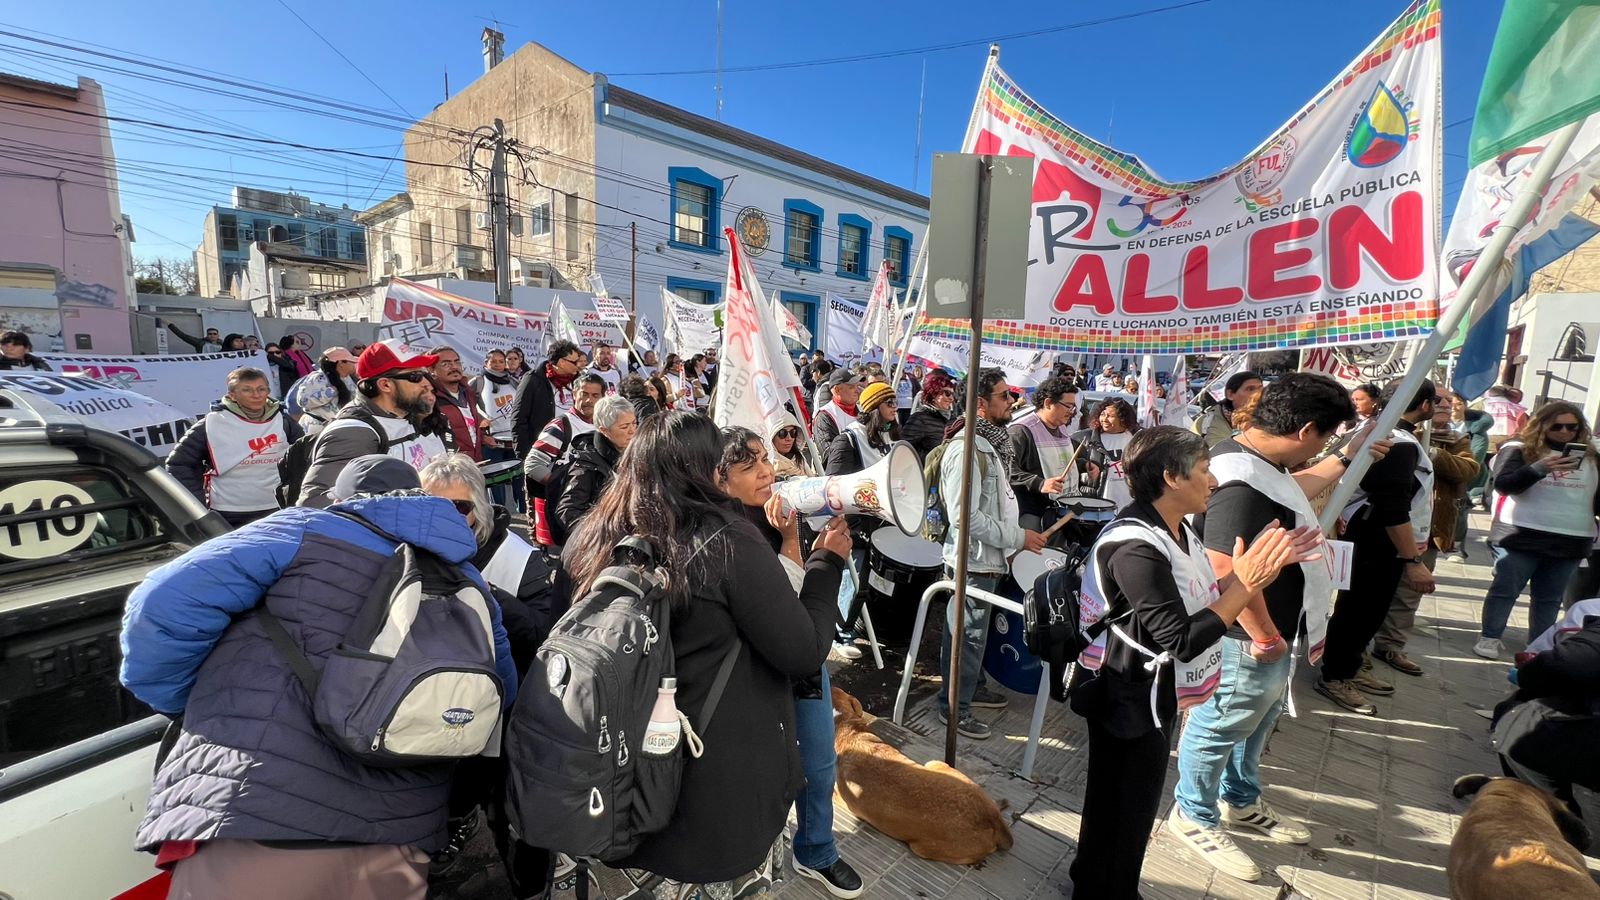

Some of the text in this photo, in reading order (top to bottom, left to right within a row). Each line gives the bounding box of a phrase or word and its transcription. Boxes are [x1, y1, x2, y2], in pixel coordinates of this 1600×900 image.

[1257, 154, 1281, 175] FUL
[1127, 170, 1421, 250] EN DEFENSA DE LA ESCUELA PÚBLICA
[1172, 219, 1192, 229] 2024
[1052, 190, 1425, 316] ALLEN
[449, 303, 517, 328] VALLE
[830, 299, 864, 319] SECCIONA
[1050, 317, 1109, 329] DOCENTE
[1113, 317, 1188, 329] LUCHANDO
[1192, 309, 1257, 326] TAMBIÉN
[1263, 303, 1304, 318] ESTÁ
[1309, 287, 1423, 313] ENSEÑANDO
[476, 337, 505, 346] DARWIN
[477, 330, 509, 339] CHIMPAY
[979, 351, 1006, 366] Escuela
[0, 494, 86, 547] 110
[1185, 666, 1204, 682] RÍO
